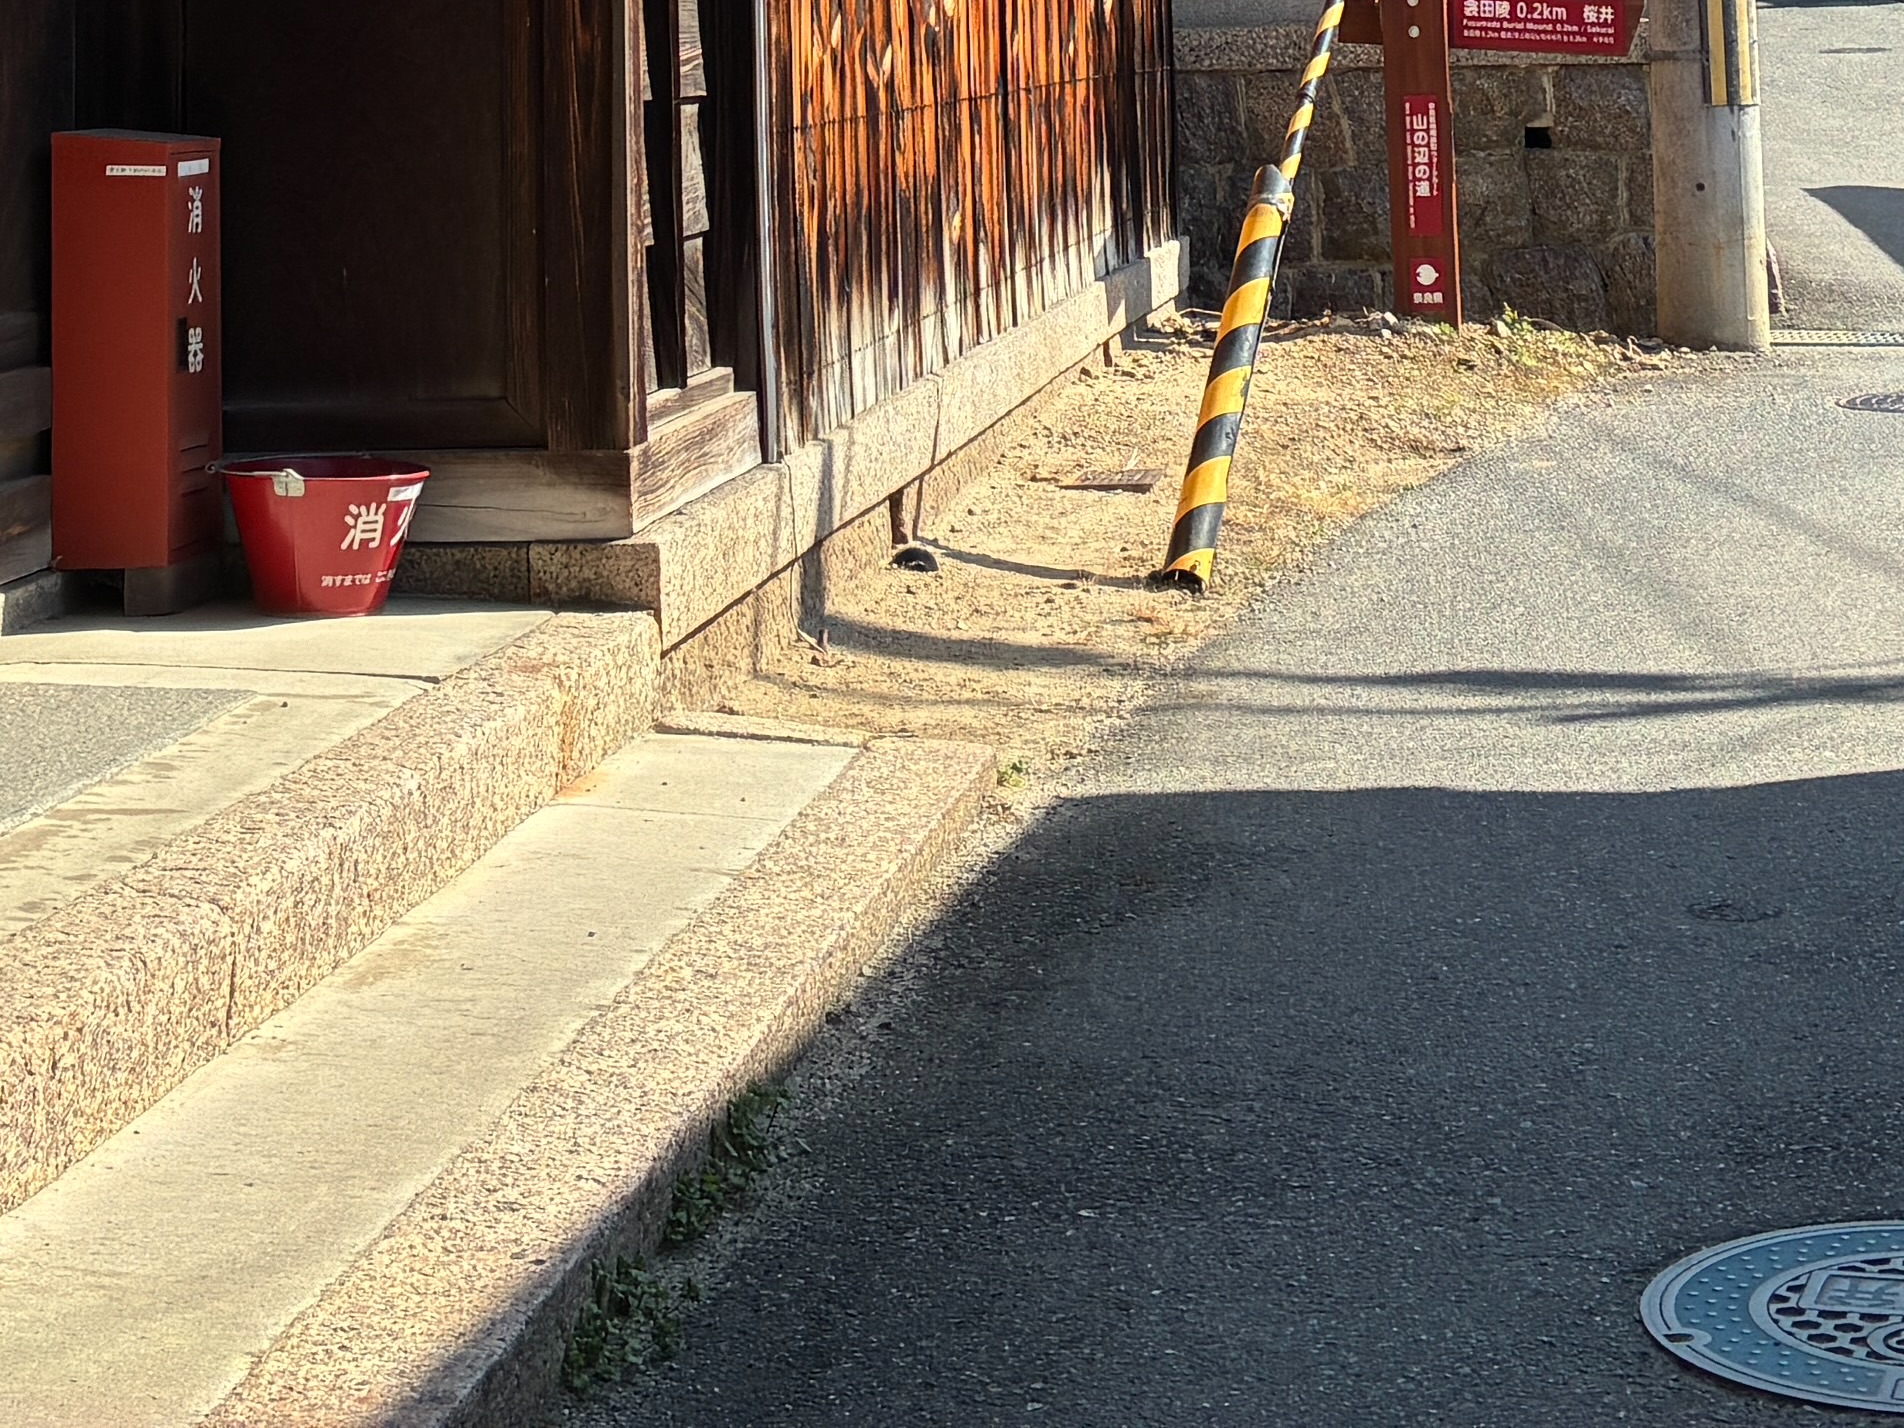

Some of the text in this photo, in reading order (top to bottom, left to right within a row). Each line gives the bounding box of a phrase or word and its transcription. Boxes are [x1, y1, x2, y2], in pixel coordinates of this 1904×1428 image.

[1516, 1, 1567, 21] 0.2km
[1582, 3, 1615, 25] 桜井
[1412, 112, 1432, 197] 山の辺の道
[187, 185, 204, 374] 消火器
